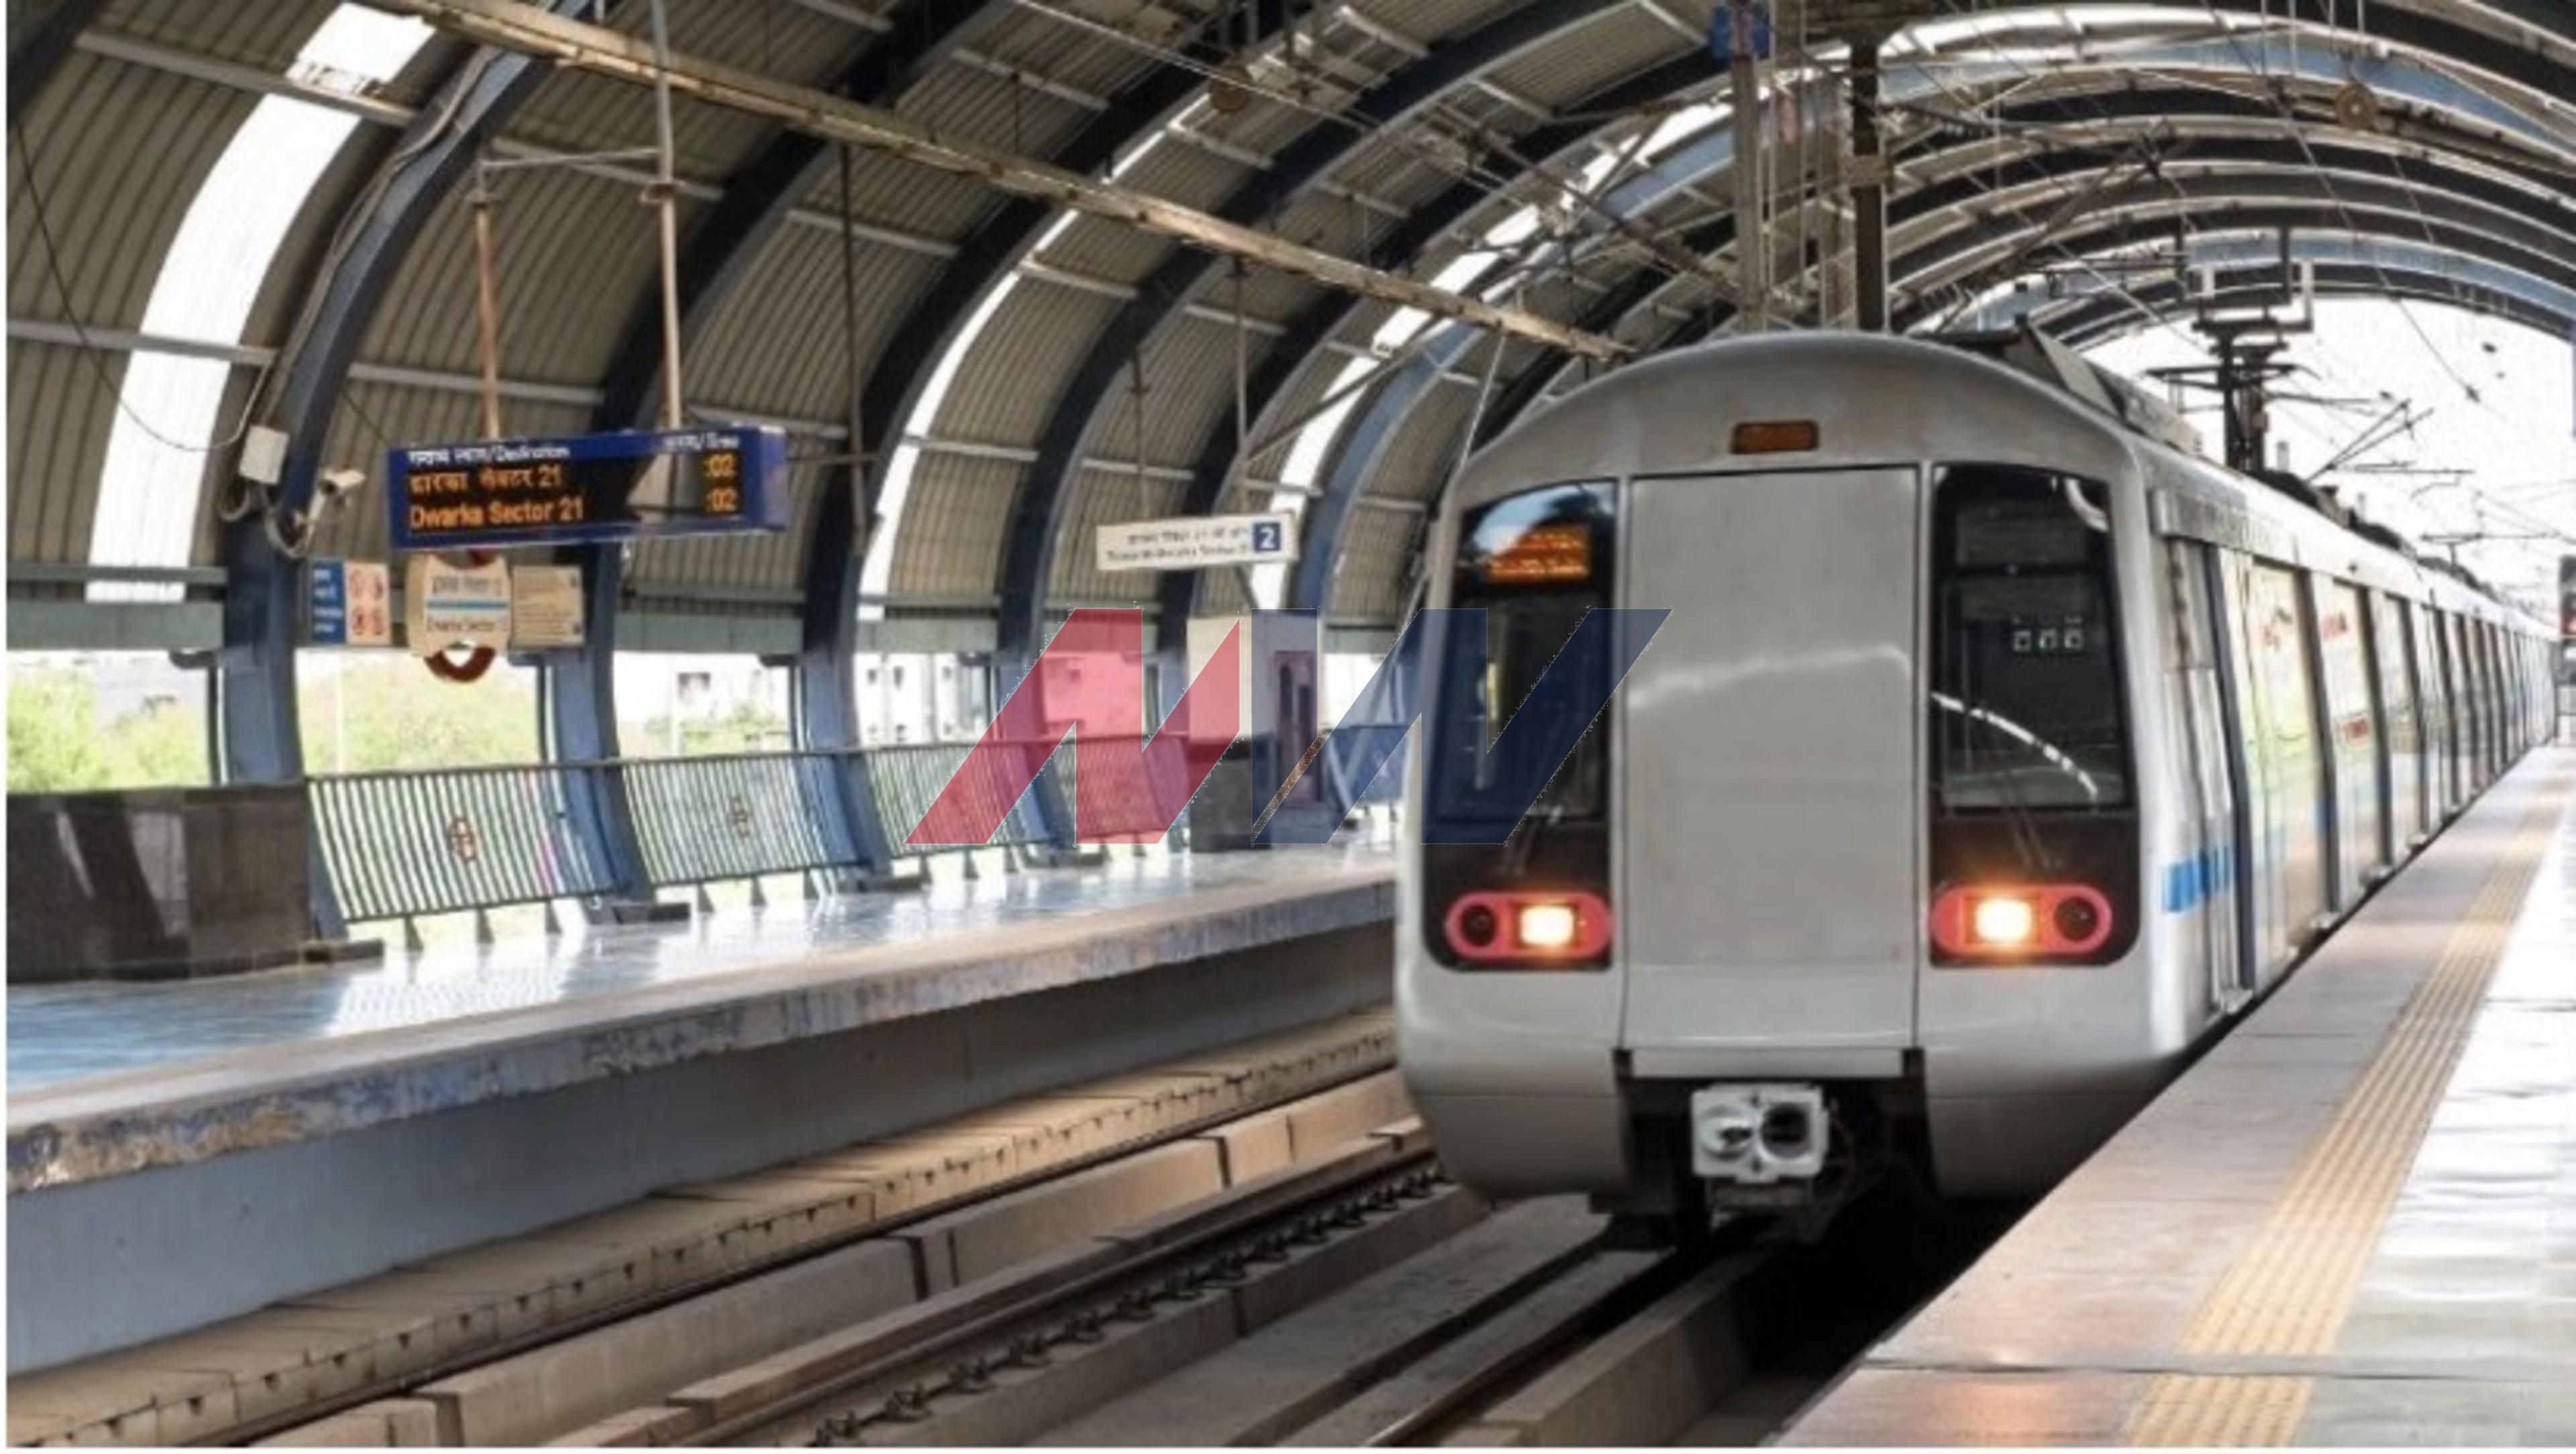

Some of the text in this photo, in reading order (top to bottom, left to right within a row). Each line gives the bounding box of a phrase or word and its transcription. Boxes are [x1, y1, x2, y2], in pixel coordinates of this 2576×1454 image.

[538, 463, 562, 488] 21
[410, 494, 584, 530] Dwarka Sector 21
[1259, 526, 1276, 549] 2
